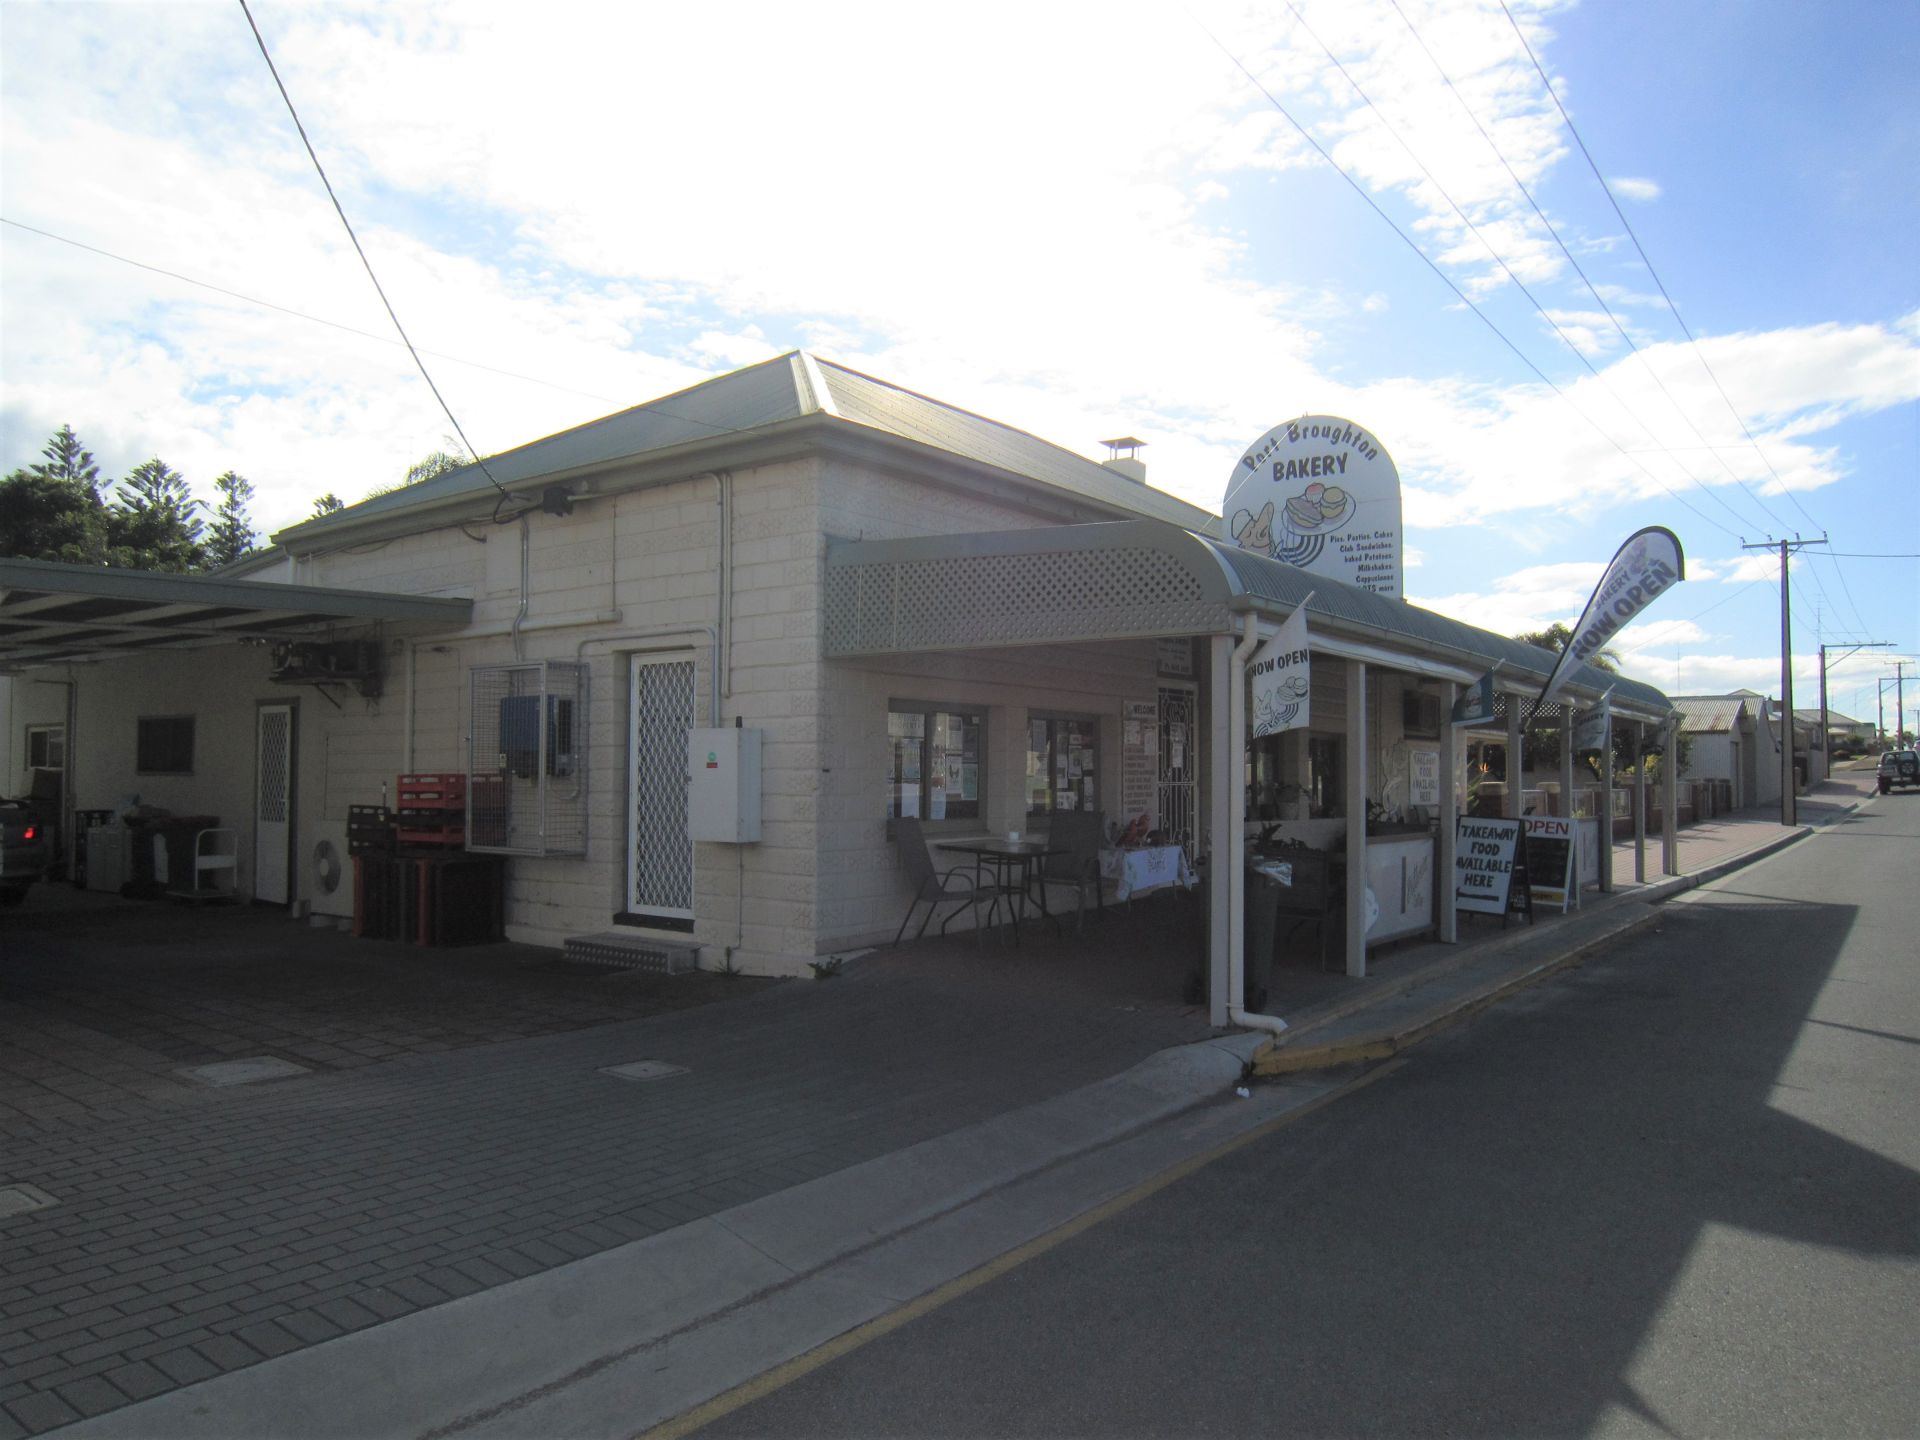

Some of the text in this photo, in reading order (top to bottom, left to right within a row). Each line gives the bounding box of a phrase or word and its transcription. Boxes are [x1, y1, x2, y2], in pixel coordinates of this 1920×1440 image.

[1242, 422, 1378, 473] Port Broughton
[1272, 452, 1348, 482] BAKERY
[1374, 531, 1393, 539] Cakes
[1572, 611, 1618, 661] NOW
[1614, 559, 1677, 617] OPEN
[1251, 649, 1310, 676] NOW OPEN
[1461, 825, 1516, 841] TAKEAWAY
[1525, 819, 1569, 835] OPEN
[1470, 841, 1500, 856] FOOD
[1456, 856, 1512, 873] AVAILABLE
[1464, 873, 1495, 888] HERE
